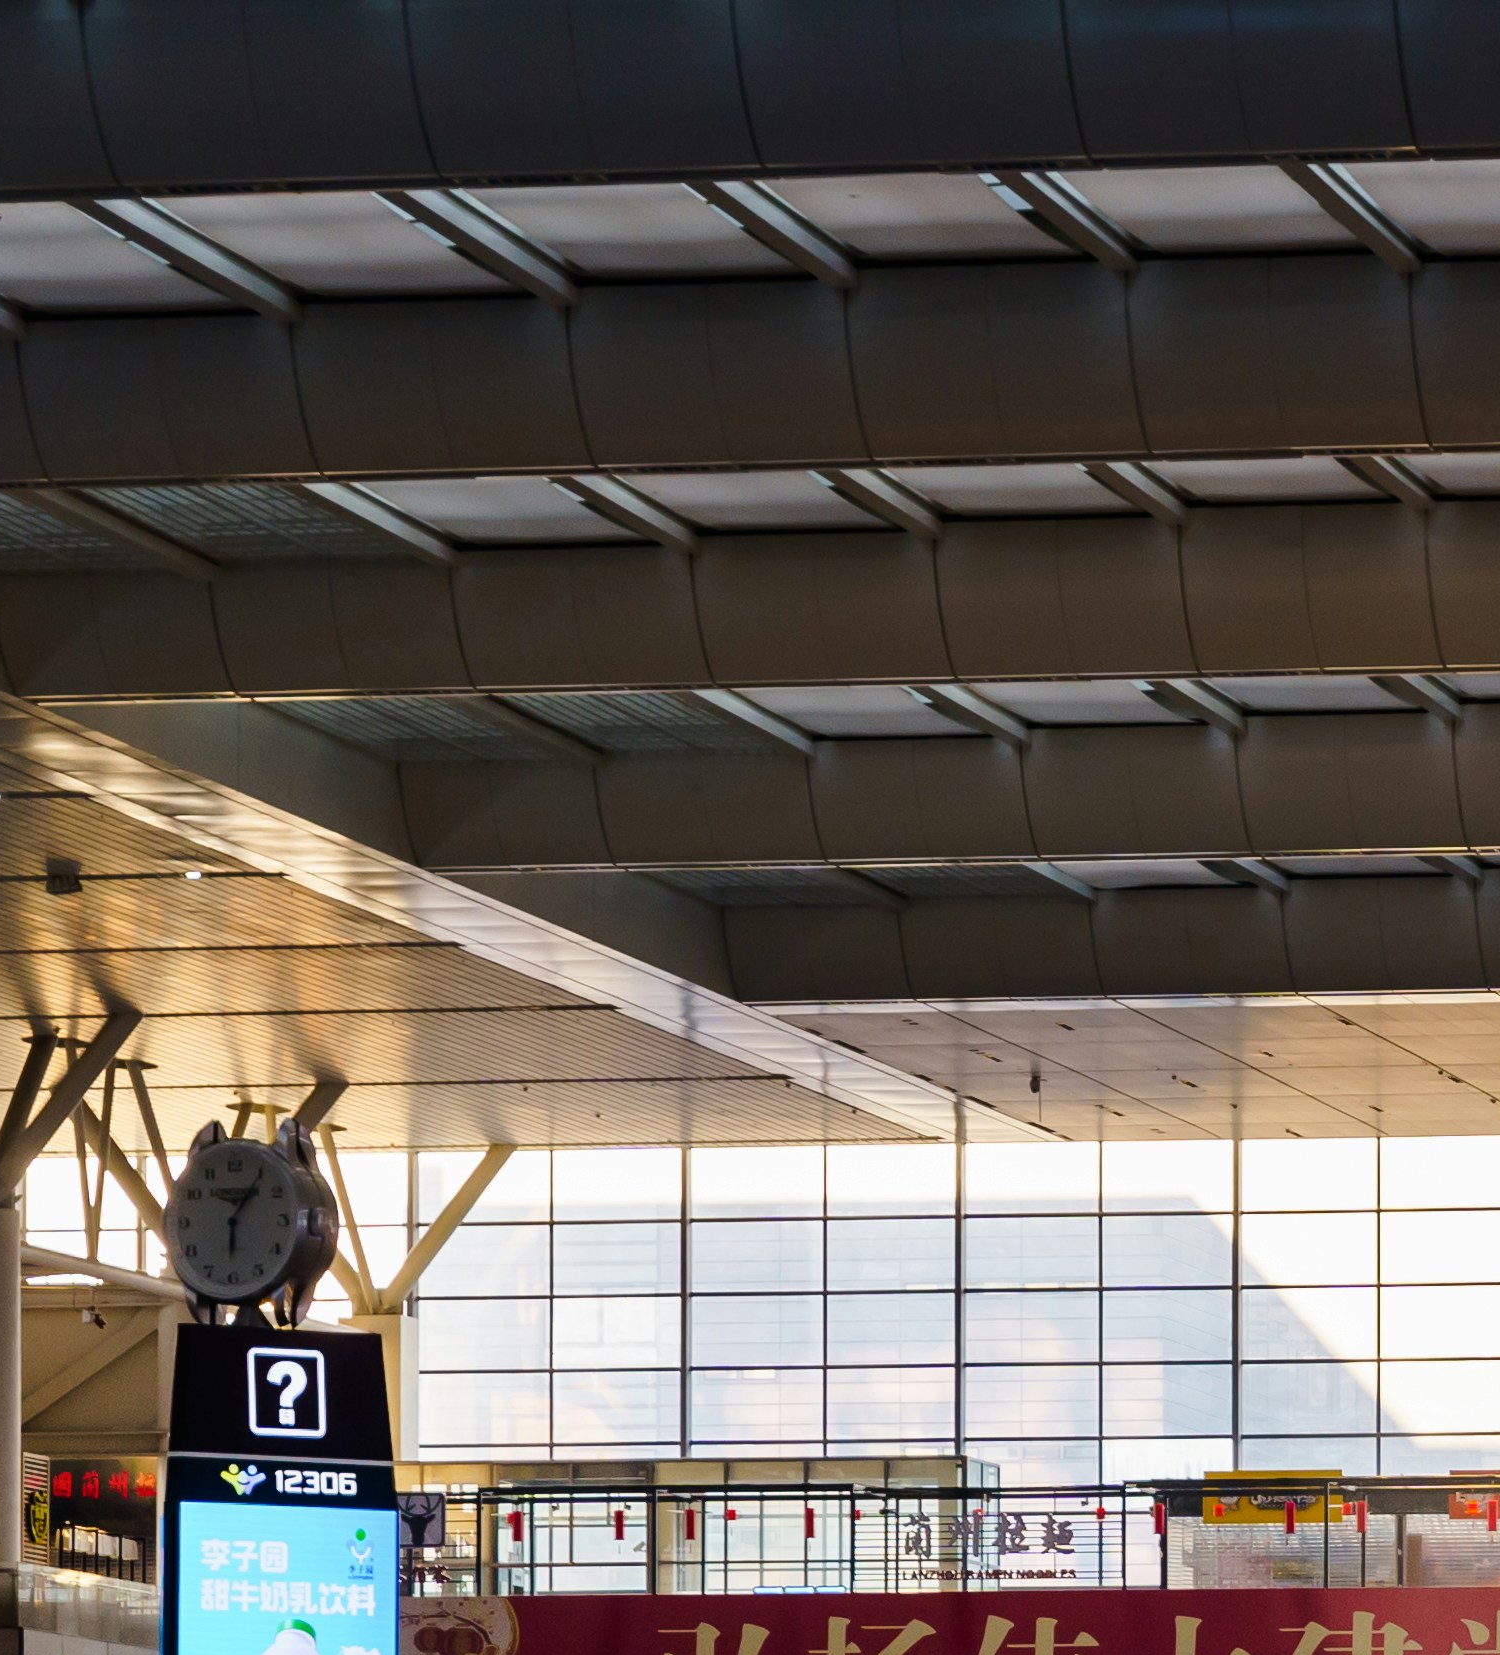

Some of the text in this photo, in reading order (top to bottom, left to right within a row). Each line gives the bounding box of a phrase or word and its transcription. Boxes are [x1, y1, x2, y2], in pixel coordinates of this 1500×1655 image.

[187, 1188, 202, 1200] 10
[271, 1187, 283, 1198] 2
[179, 1216, 190, 1229] 9
[277, 1214, 290, 1226] 3
[186, 1245, 198, 1257] 8
[269, 1243, 281, 1255] 4
[203, 1266, 214, 1278] 7
[252, 1264, 264, 1276] 5
[227, 1272, 240, 1284] 6
[274, 1469, 358, 1496] 12306
[200, 1539, 289, 1574] 李子园
[902, 1569, 1077, 1580] LANZHOU RAMEN NOODLES
[200, 1579, 377, 1617] 甜牛奶乳饮料
